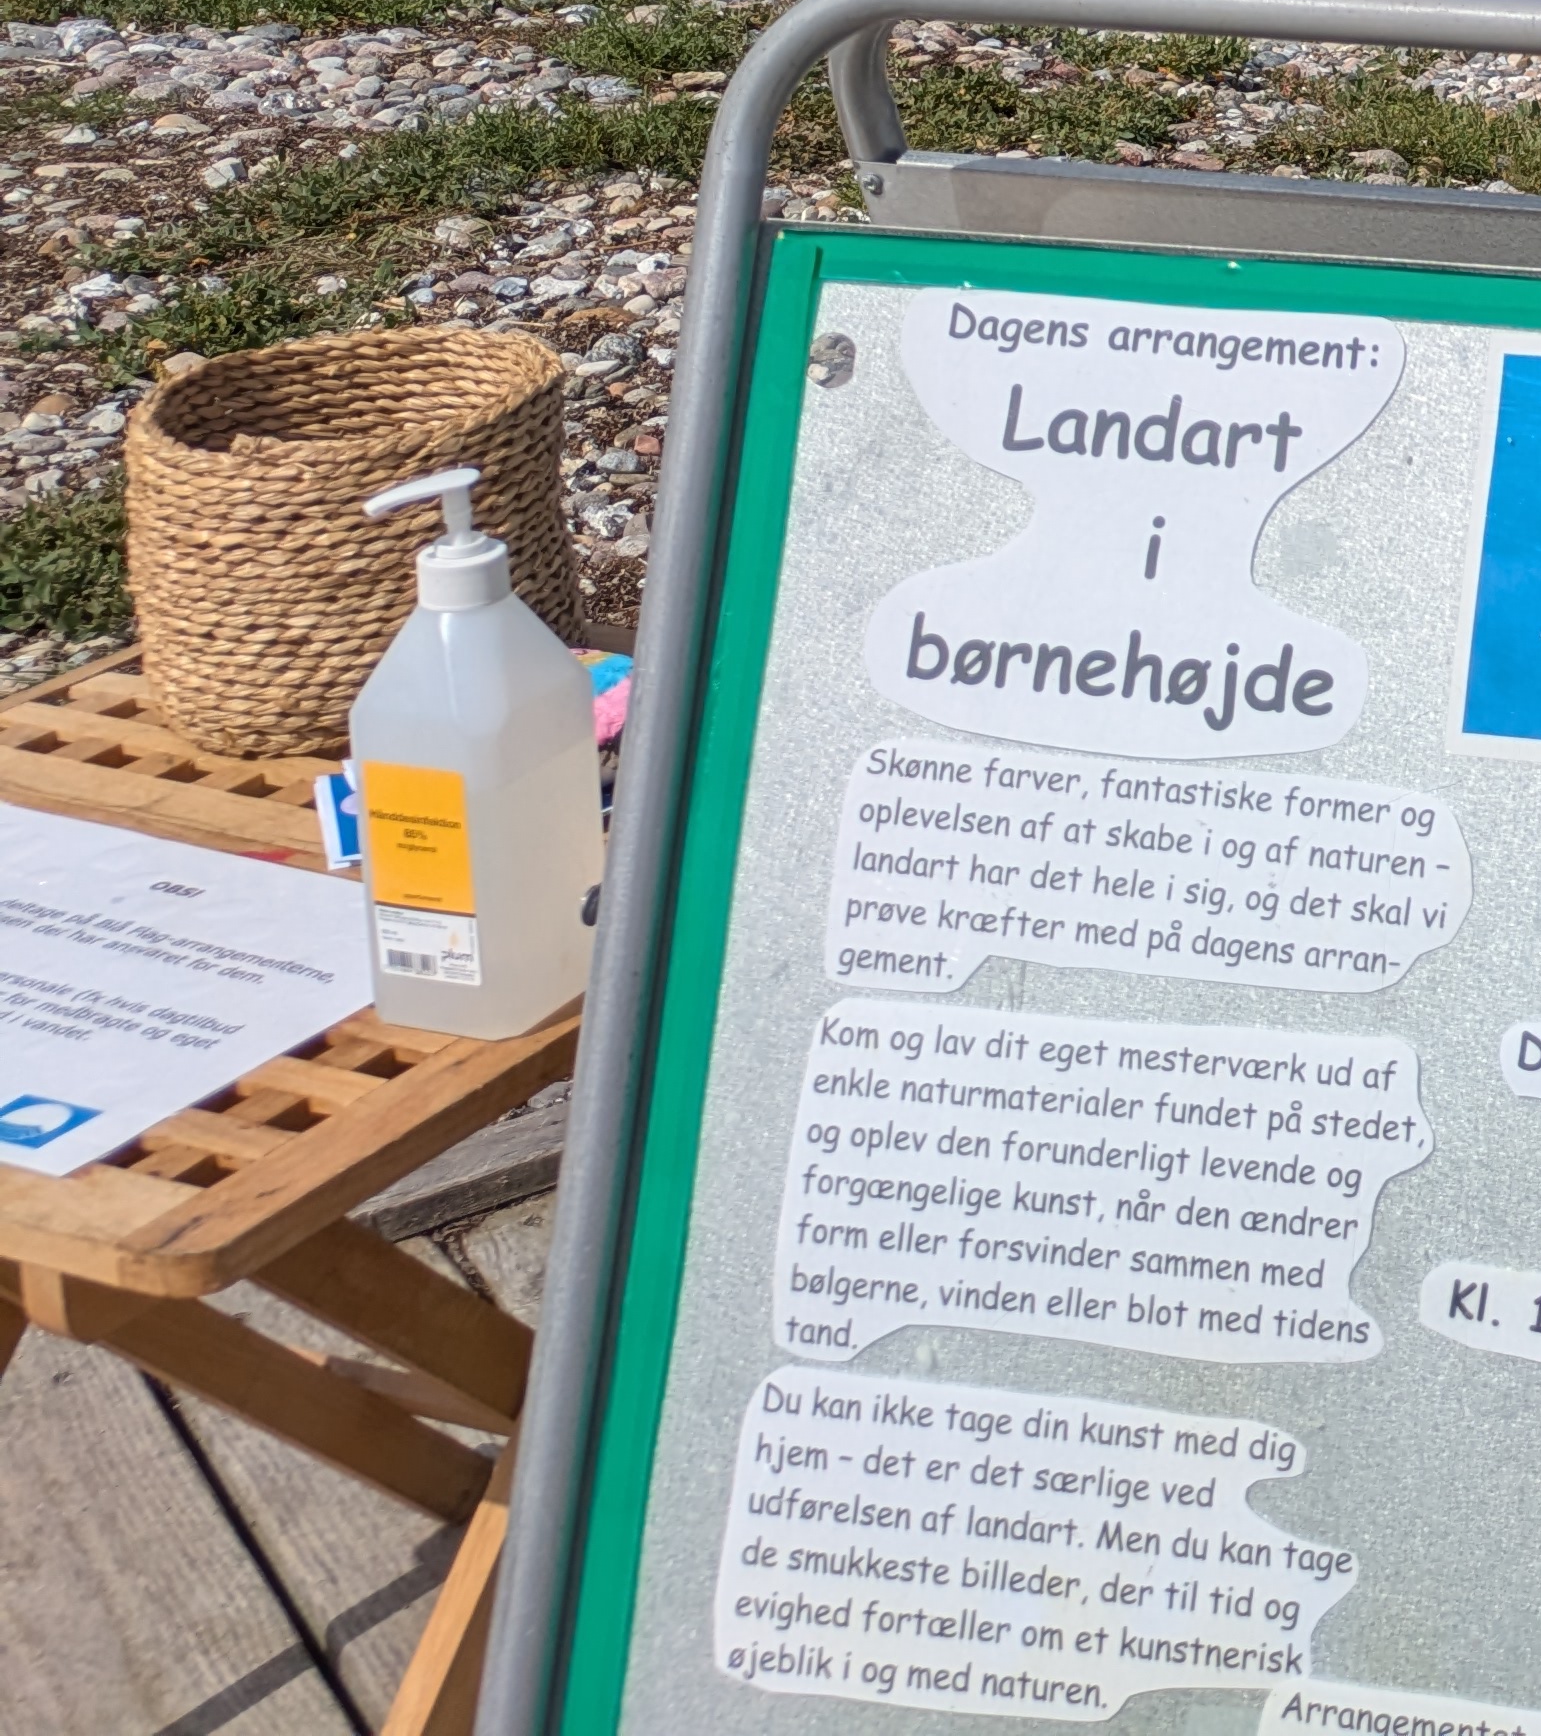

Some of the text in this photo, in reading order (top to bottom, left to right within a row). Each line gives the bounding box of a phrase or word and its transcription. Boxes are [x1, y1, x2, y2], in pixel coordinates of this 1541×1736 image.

[948, 302, 1379, 371] Dagens arrangement:
[1002, 383, 1303, 473] Landart
[1144, 515, 1166, 580] i
[906, 611, 1334, 732] børnehøjde
[866, 748, 1436, 837] Skønne farver, fantastiske former og
[859, 796, 1425, 878] oplevelsen af at skabe i og af naturen
[149, 880, 206, 899] OBS!
[853, 841, 1446, 929] landart har det hele i sig, og det skal vi
[836, 947, 953, 980] gement.
[845, 898, 1401, 975] prøve kræfter med på dagens arran-
[820, 1016, 1398, 1092] Kom og lav dit eget mesterværk ud af
[813, 1067, 1425, 1149] enkle naturmaterialer fundet på stedet,
[806, 1120, 1363, 1199] og oplev den forunderligt levende og
[802, 1163, 1359, 1240] forgængelige kunst, når den ændrer
[797, 1212, 1326, 1289] form eller forsvinder sammen med
[785, 1316, 860, 1350] tand.
[790, 1262, 1370, 1344] bølgerne, vinden eller blot med tidens
[1448, 1278, 1500, 1328] Kl.
[762, 1382, 1296, 1472] Du kan ikke tage din kunst med dig
[755, 1432, 1216, 1509] hjem det er det særlige ved
[748, 1486, 1353, 1582] udførelsen af landart. Men du kan tage
[741, 1535, 1301, 1632] de smukkeste billeder, der til tid og
[734, 1592, 1303, 1675] evighed fortæller om et kunstnerisk
[727, 1643, 1107, 1709] øjeblik i og med naturen.
